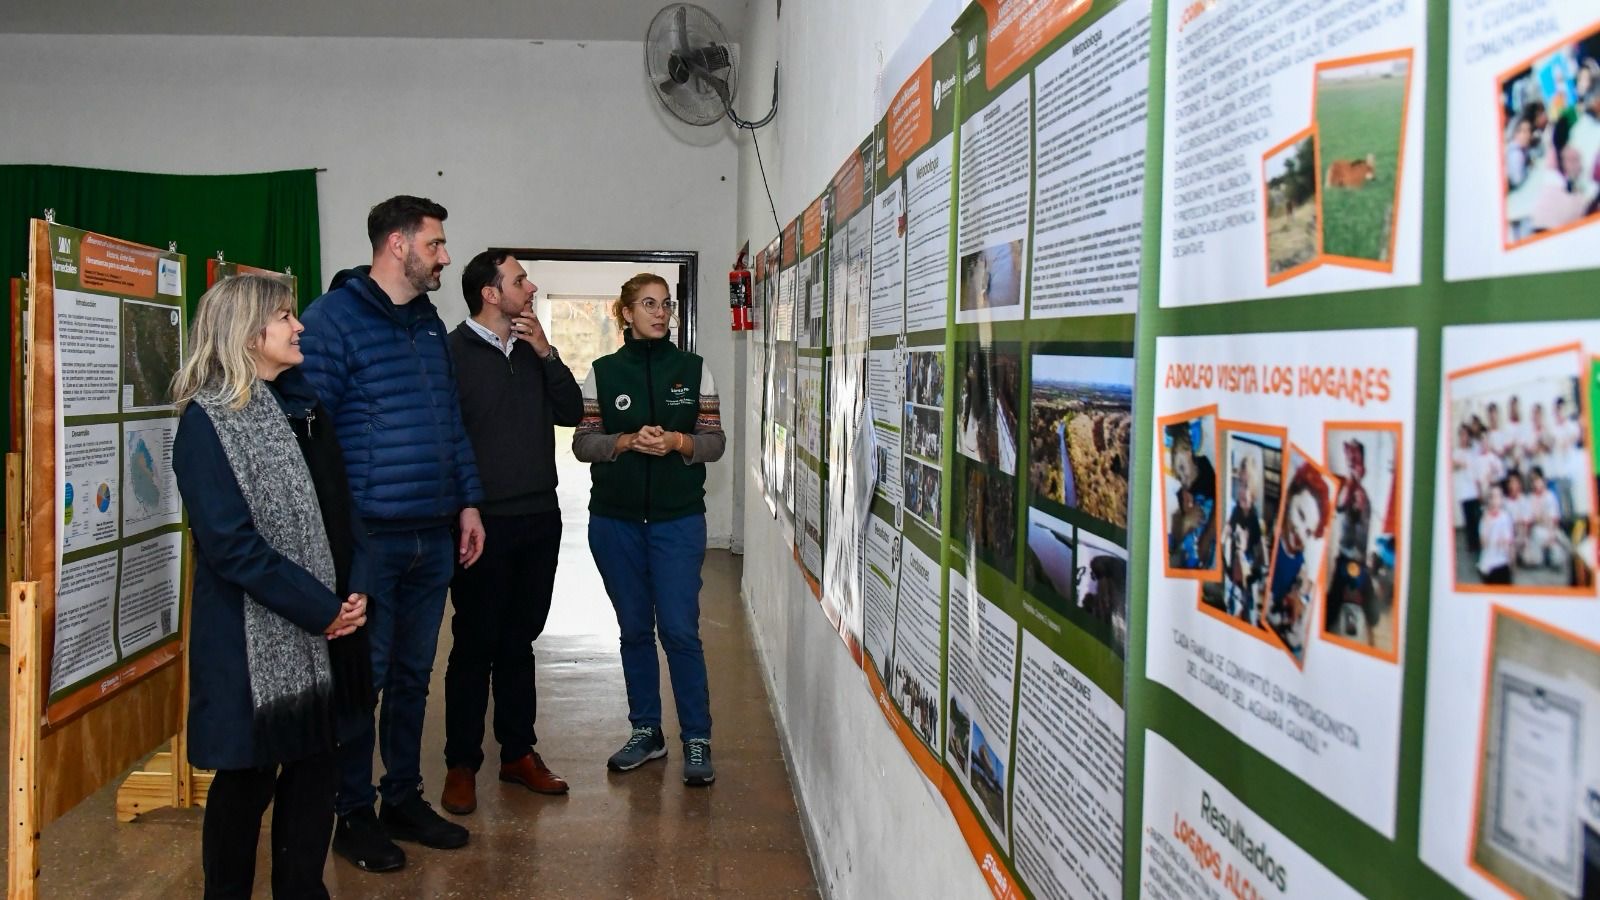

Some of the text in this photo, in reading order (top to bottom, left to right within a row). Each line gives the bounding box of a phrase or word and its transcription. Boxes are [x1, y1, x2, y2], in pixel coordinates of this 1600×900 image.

[1165, 363, 1391, 408] ADOLFO VISITA LOS HOGARES
[1173, 811, 1222, 880] LOGROS
[1201, 789, 1287, 893] Resultados
